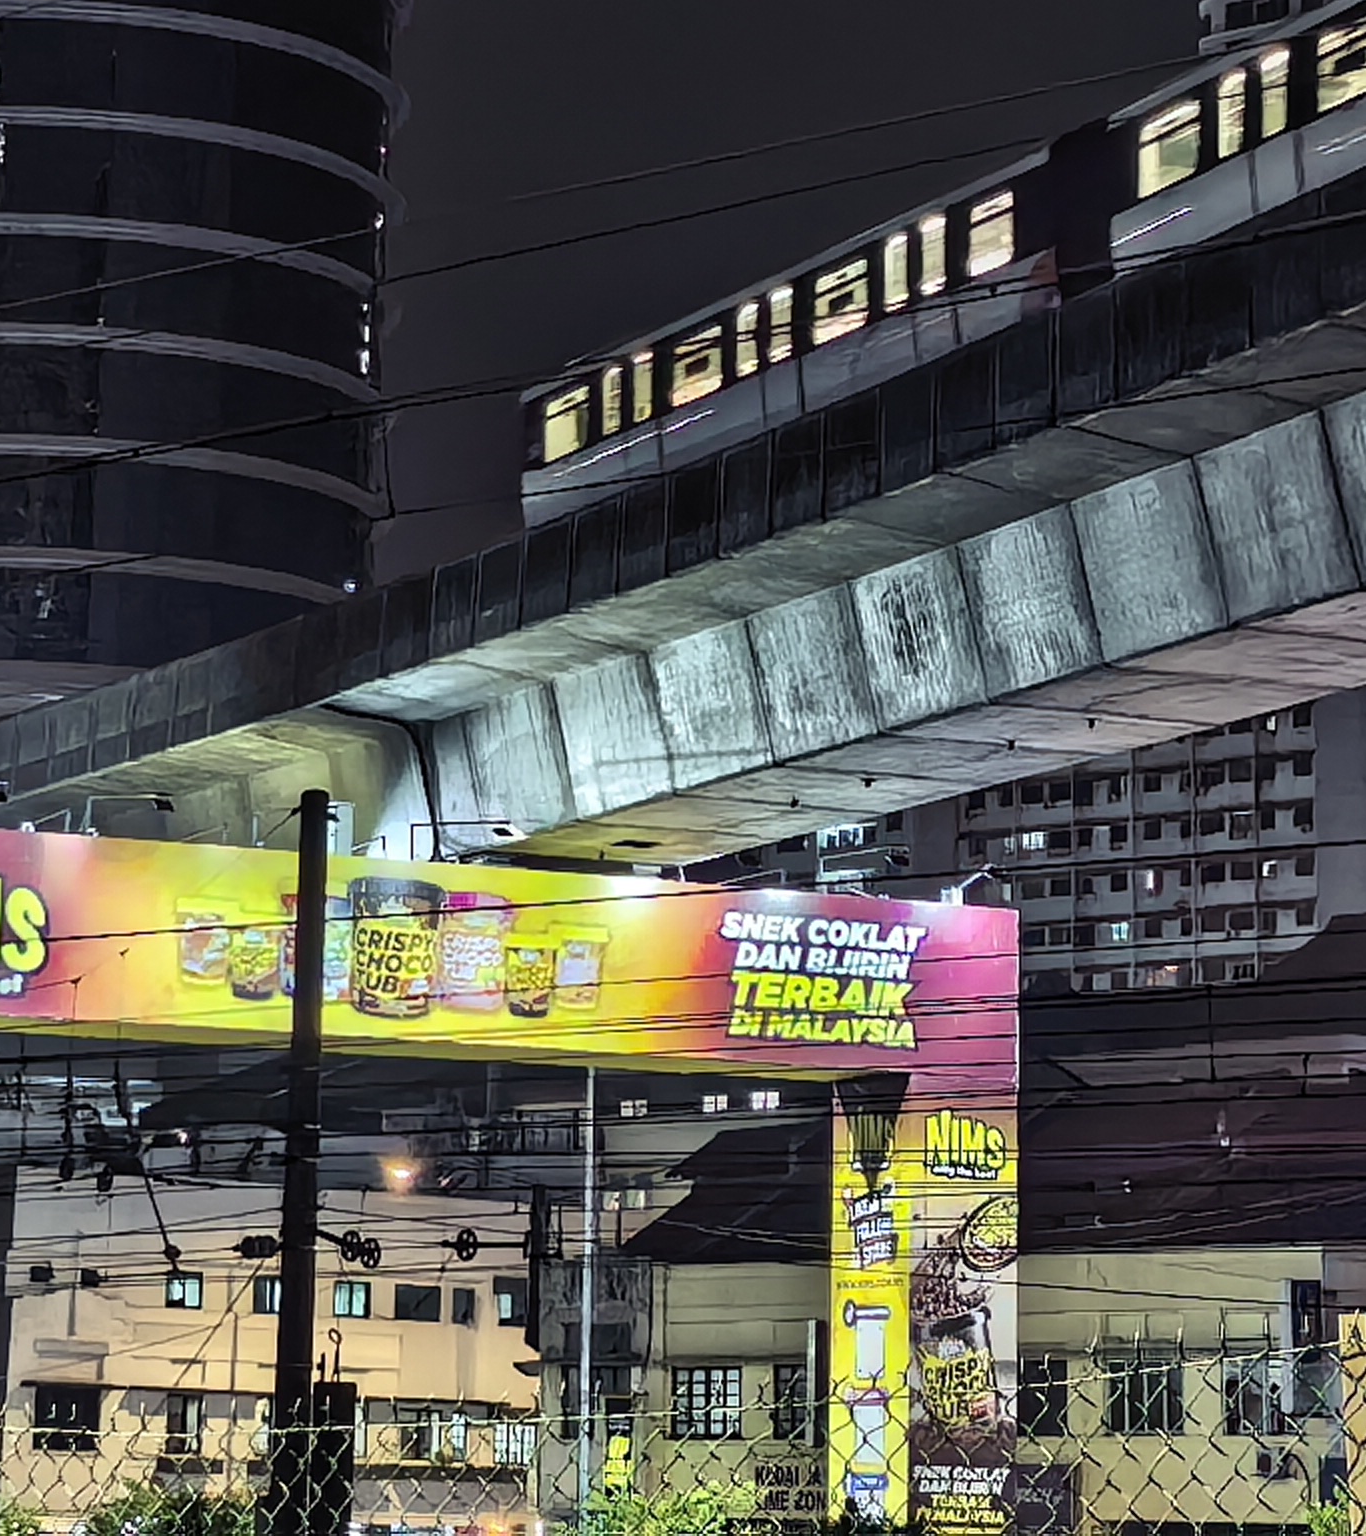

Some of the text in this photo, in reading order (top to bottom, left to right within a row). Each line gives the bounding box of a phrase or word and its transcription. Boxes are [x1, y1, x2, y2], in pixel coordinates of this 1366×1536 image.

[356, 927, 433, 952] CRISPY
[720, 911, 927, 953] SNEK COKLAT
[356, 950, 433, 974] CHOCO
[734, 941, 803, 970] DAN
[356, 968, 399, 994] TUB
[731, 970, 914, 1015] TERBAIK
[766, 1014, 916, 1048] MALAYSIA
[926, 1110, 1005, 1170] NIMS
